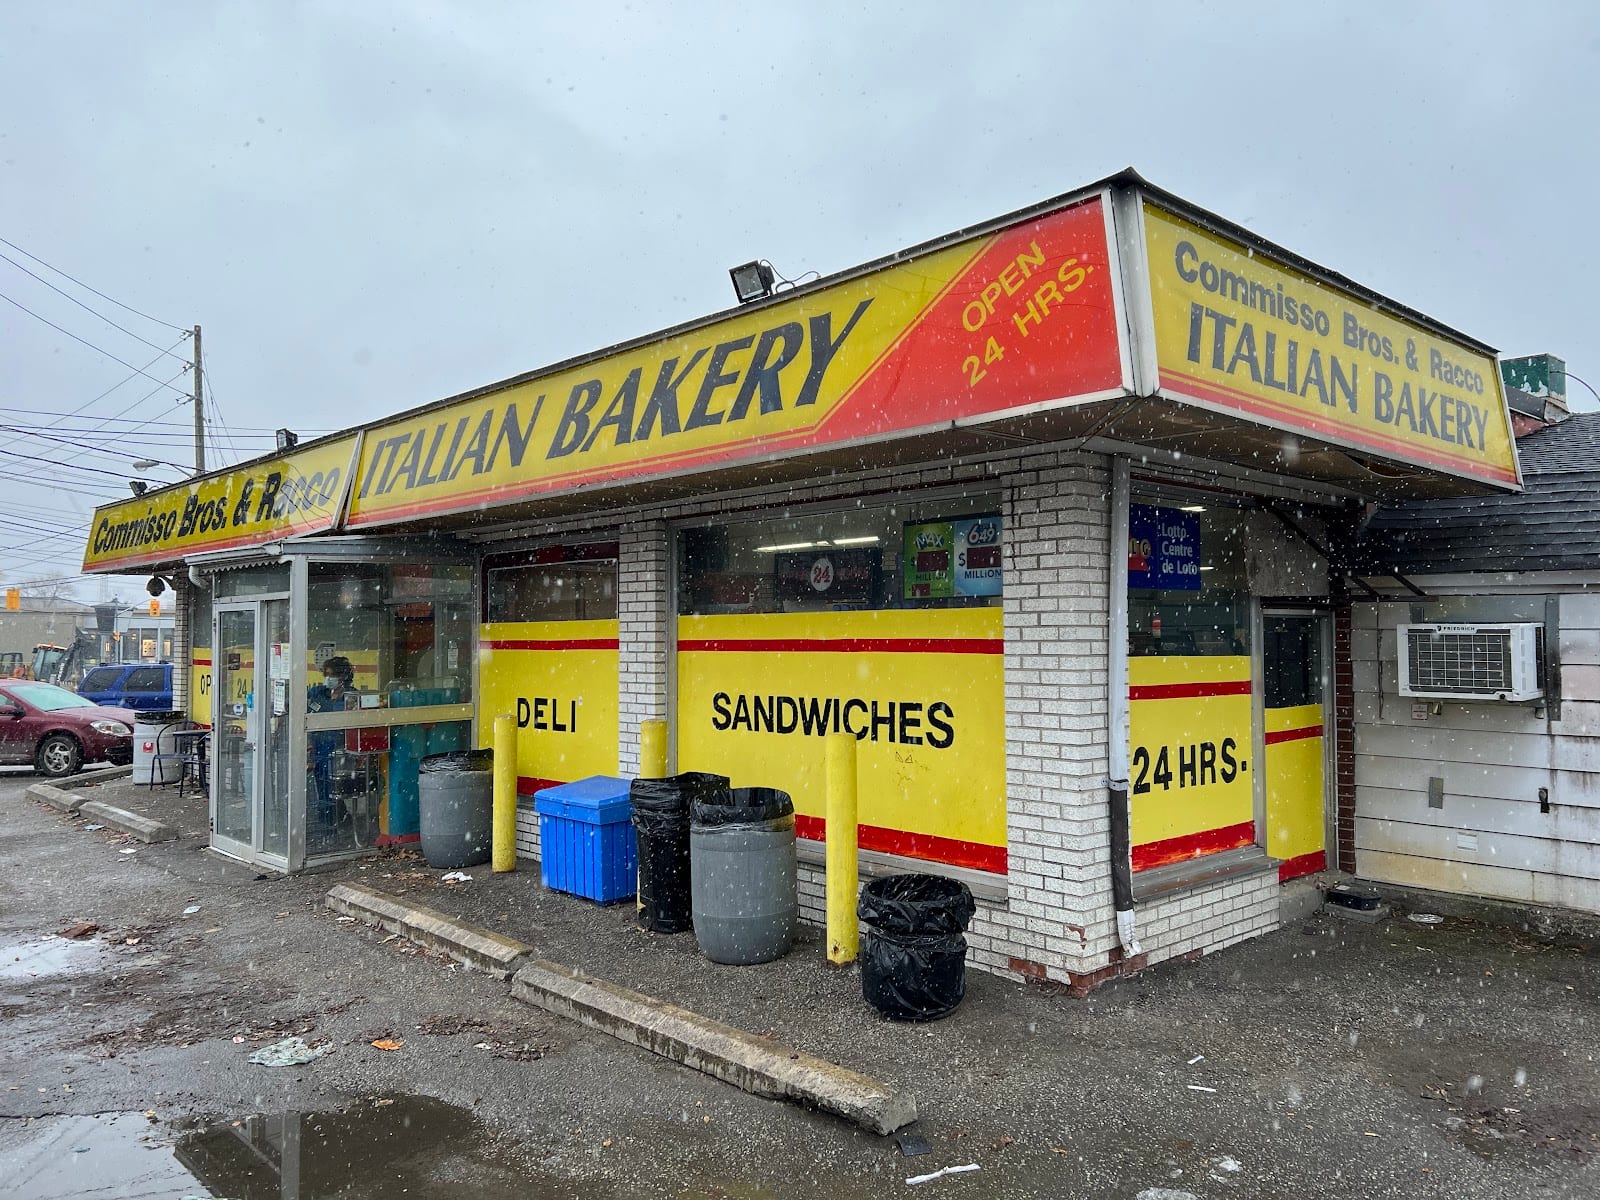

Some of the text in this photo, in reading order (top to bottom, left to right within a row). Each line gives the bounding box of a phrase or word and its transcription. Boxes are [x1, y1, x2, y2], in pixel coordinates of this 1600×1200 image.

[962, 240, 1046, 332] OPEN
[962, 258, 1094, 387] 24 HRS.
[1175, 240, 1484, 396] Commisso Bros. & Racco
[360, 298, 875, 500] ITALIAN BAKERY
[1187, 302, 1489, 452] ITALIAN BAKERY
[93, 466, 341, 555] Commisso Bros. & Racco
[1161, 522, 1187, 538] Lotto
[813, 565, 830, 583] 24
[958, 552, 966, 567] $
[1161, 540, 1194, 557] Centre
[1161, 559, 1198, 576] de Loto
[517, 697, 576, 733] DELI
[712, 692, 955, 748] SANDWICHES
[1132, 737, 1247, 795] 24 HRS.
